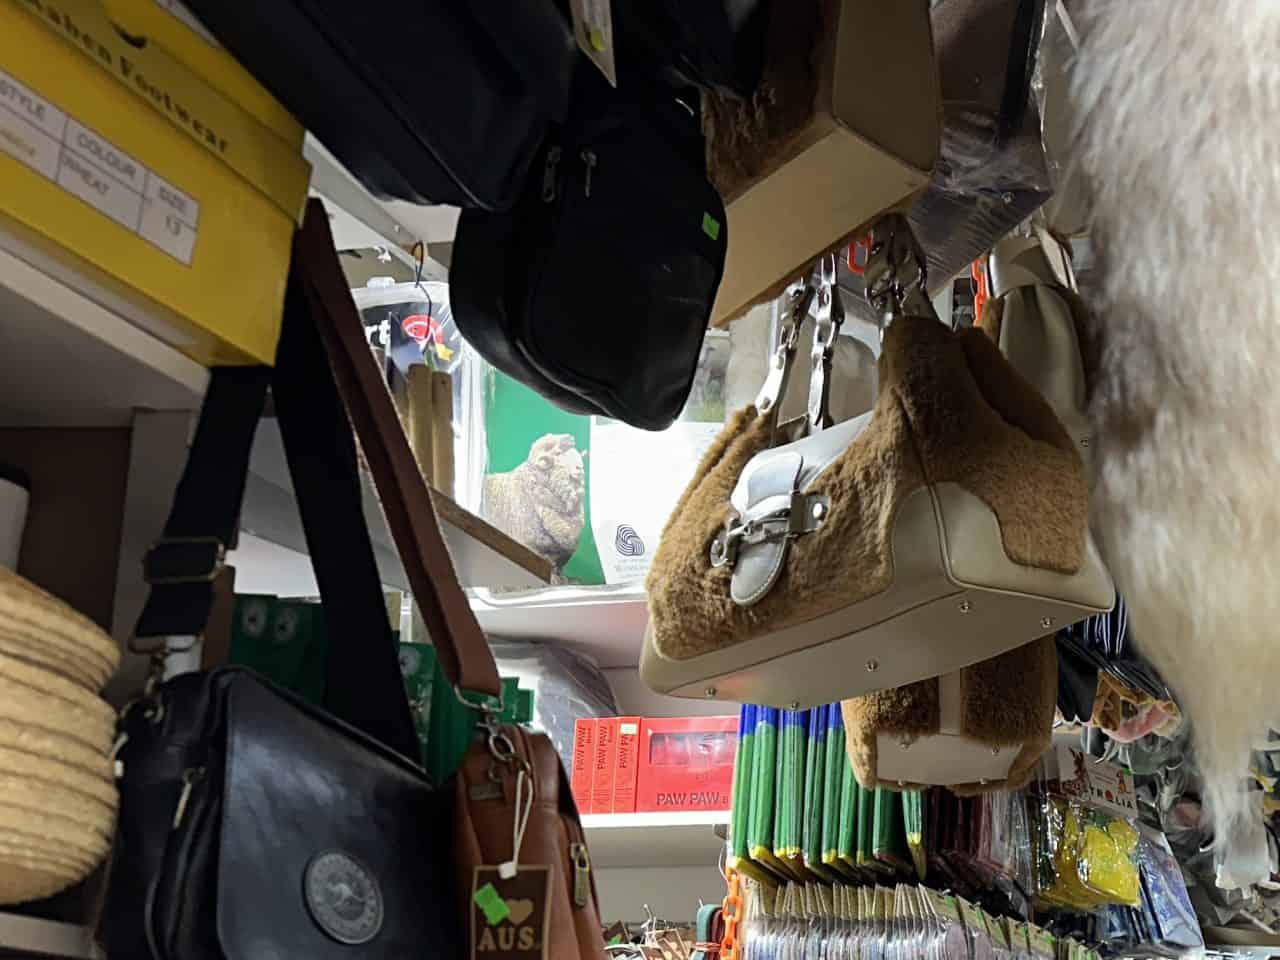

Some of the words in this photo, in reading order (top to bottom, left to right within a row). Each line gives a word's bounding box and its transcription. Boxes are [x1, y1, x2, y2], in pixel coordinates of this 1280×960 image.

[599, 726, 608, 747] PAW
[597, 749, 607, 770] PAW
[656, 792, 687, 806] PAW
[690, 791, 720, 805] PAW
[477, 926, 537, 951] AUS
